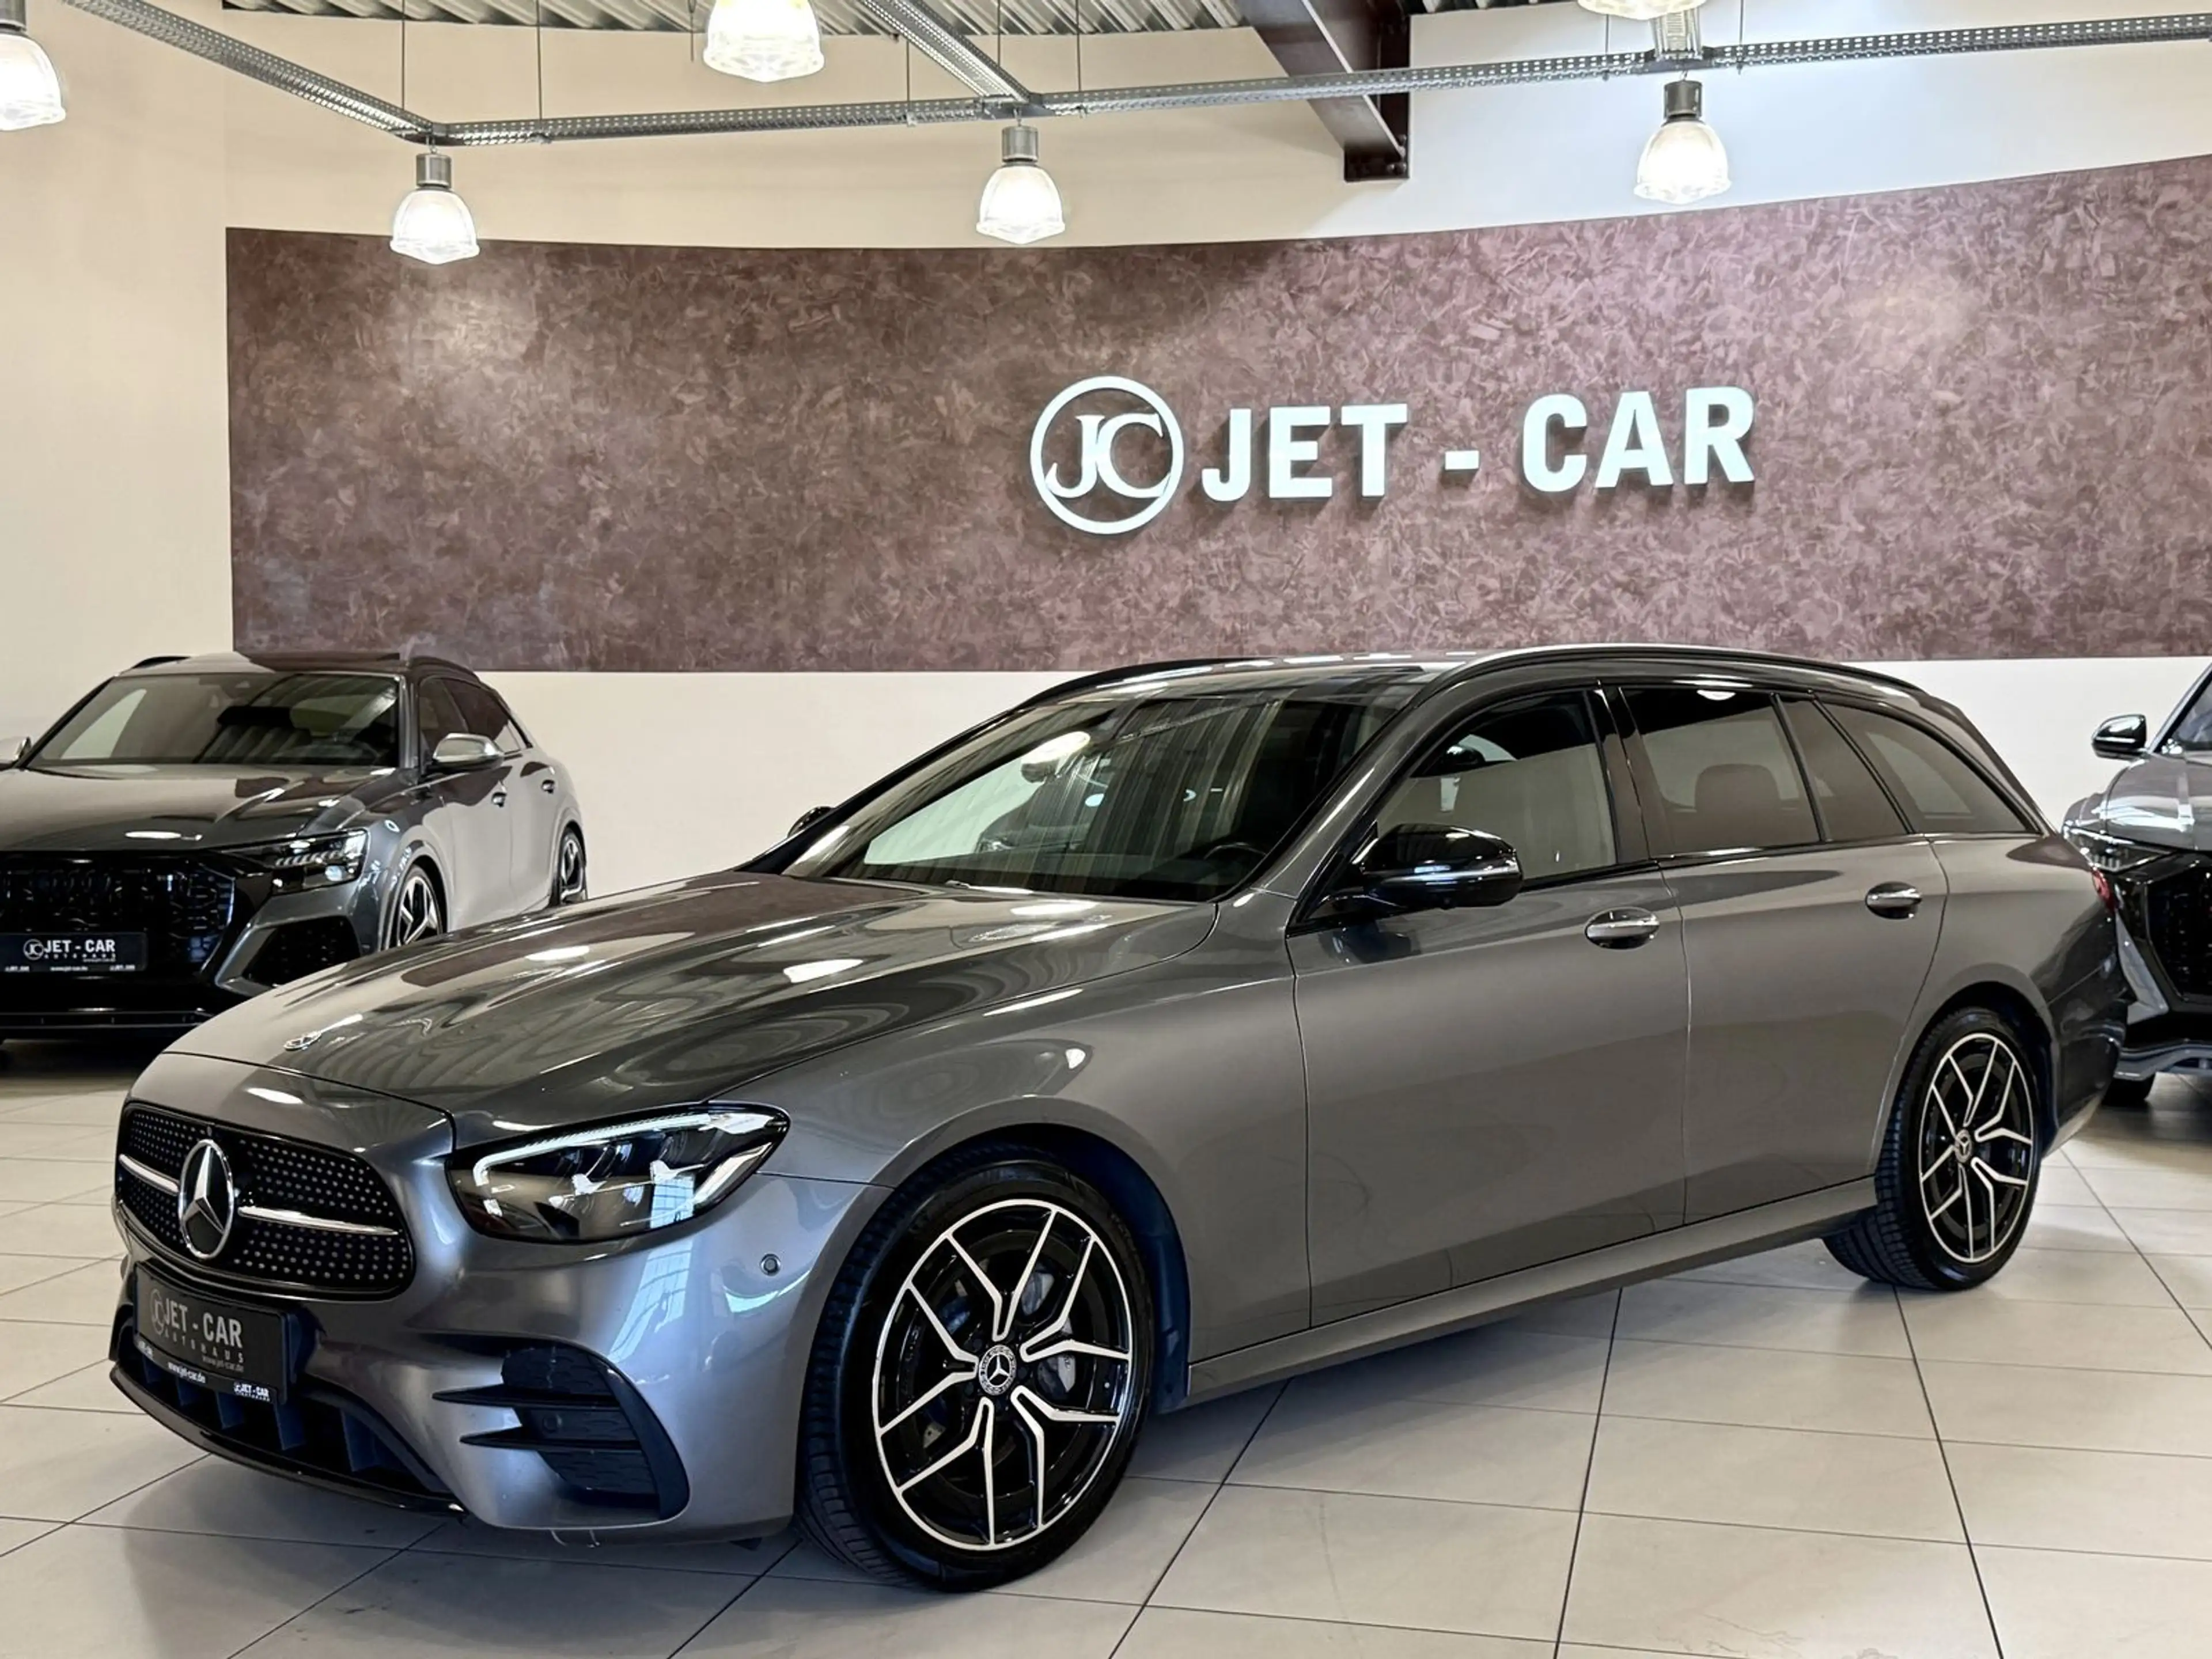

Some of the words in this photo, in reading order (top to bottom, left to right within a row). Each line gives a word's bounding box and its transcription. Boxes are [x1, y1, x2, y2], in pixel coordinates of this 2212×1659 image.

[1201, 403, 1408, 502] JET
[1444, 449, 1480, 471] -
[1521, 385, 1756, 493] CAR
[44, 940, 72, 953] JET
[85, 939, 116, 953] CAR
[165, 1298, 188, 1332] JET
[203, 1312, 243, 1349] CAR
